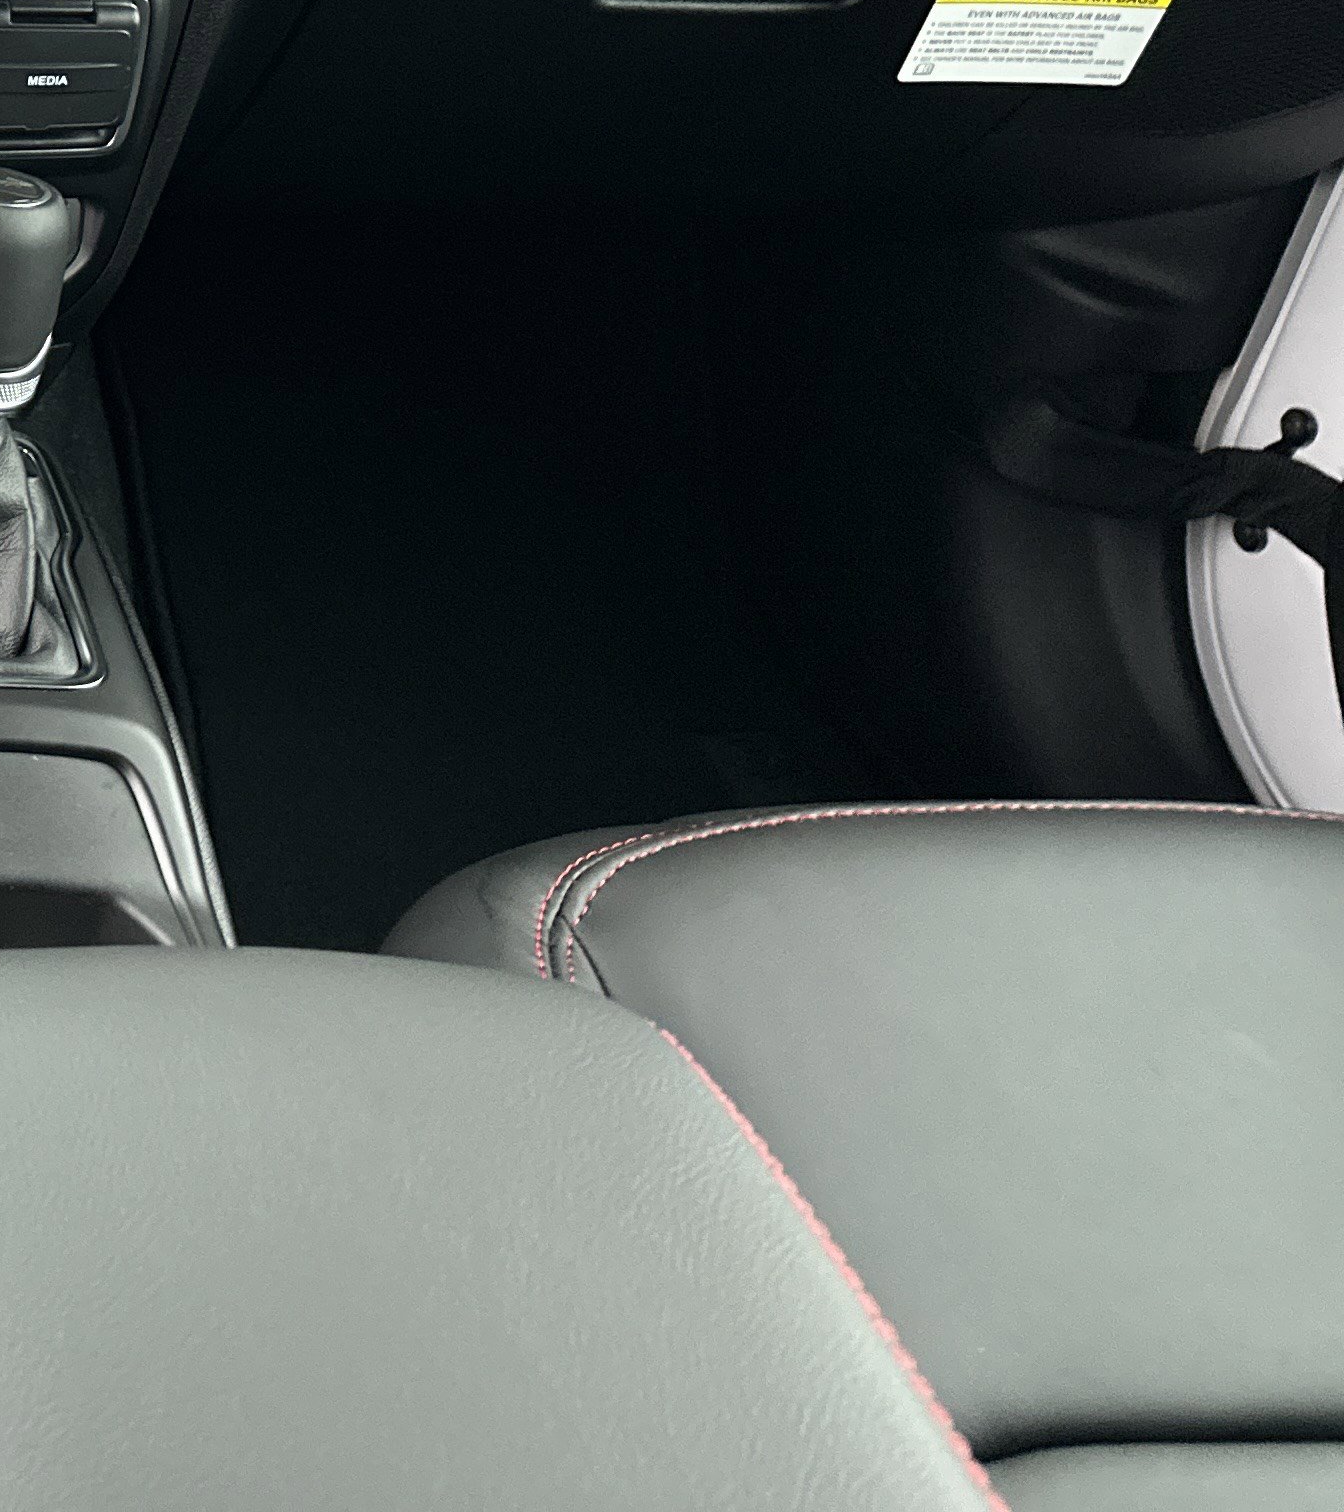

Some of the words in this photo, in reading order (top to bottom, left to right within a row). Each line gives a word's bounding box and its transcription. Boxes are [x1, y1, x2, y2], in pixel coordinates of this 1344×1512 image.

[967, 9, 994, 20] EVEN
[995, 9, 1021, 20] WITH
[1022, 10, 1074, 21] ADVANCED
[1076, 11, 1092, 21] AIR
[27, 75, 68, 86] MEDIA
